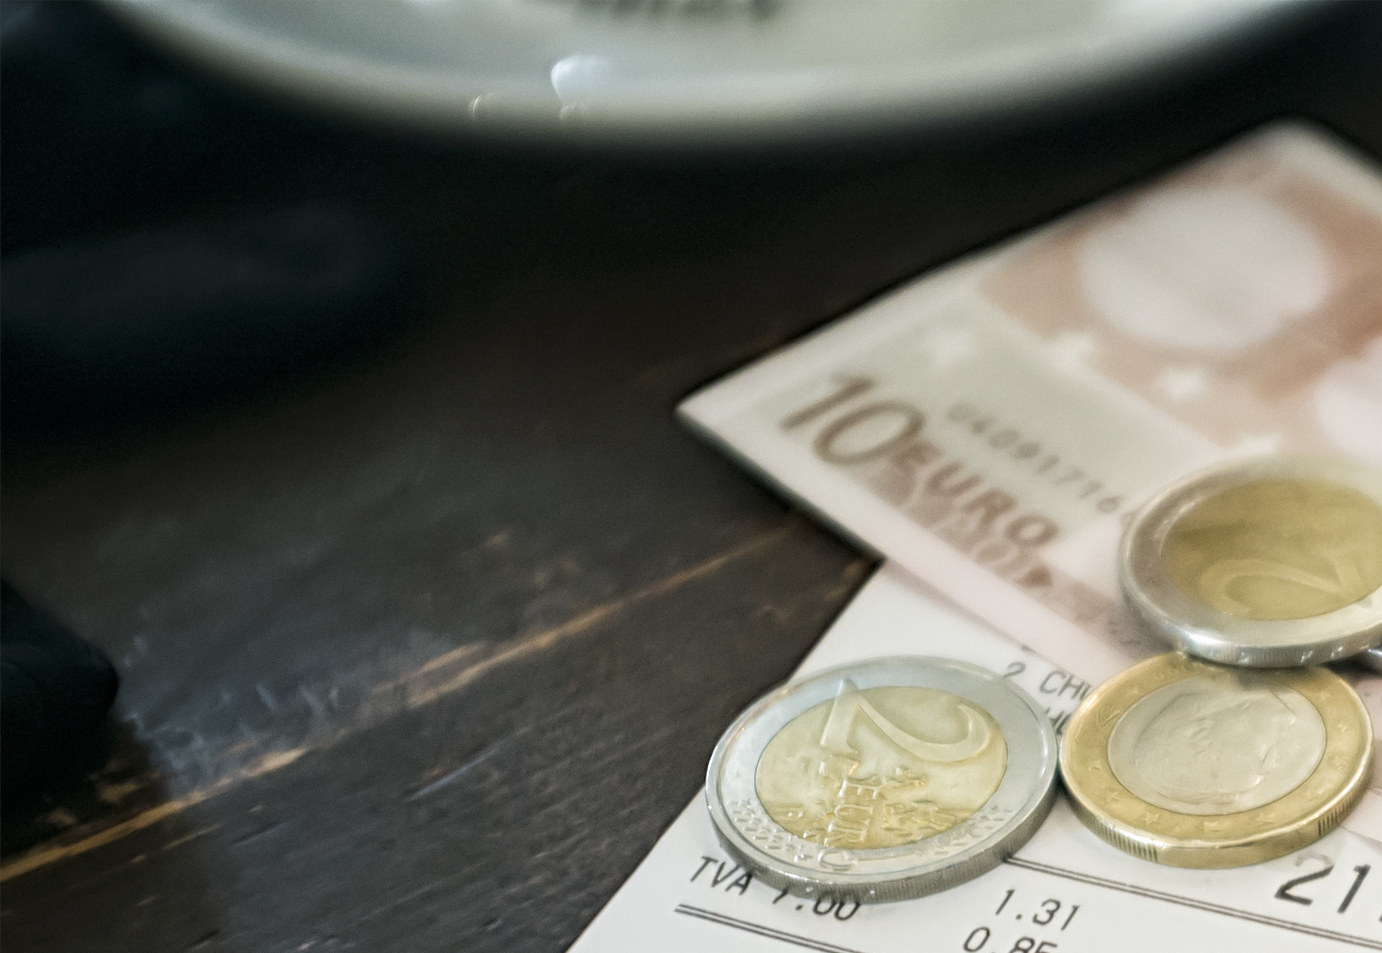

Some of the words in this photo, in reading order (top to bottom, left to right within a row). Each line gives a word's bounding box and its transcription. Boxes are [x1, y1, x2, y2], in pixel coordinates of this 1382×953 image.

[779, 374, 926, 467] 10
[892, 440, 1058, 549] EURO
[944, 400, 1140, 526] U4091716
[689, 856, 755, 896] TVA
[994, 889, 1080, 931] 1.31
